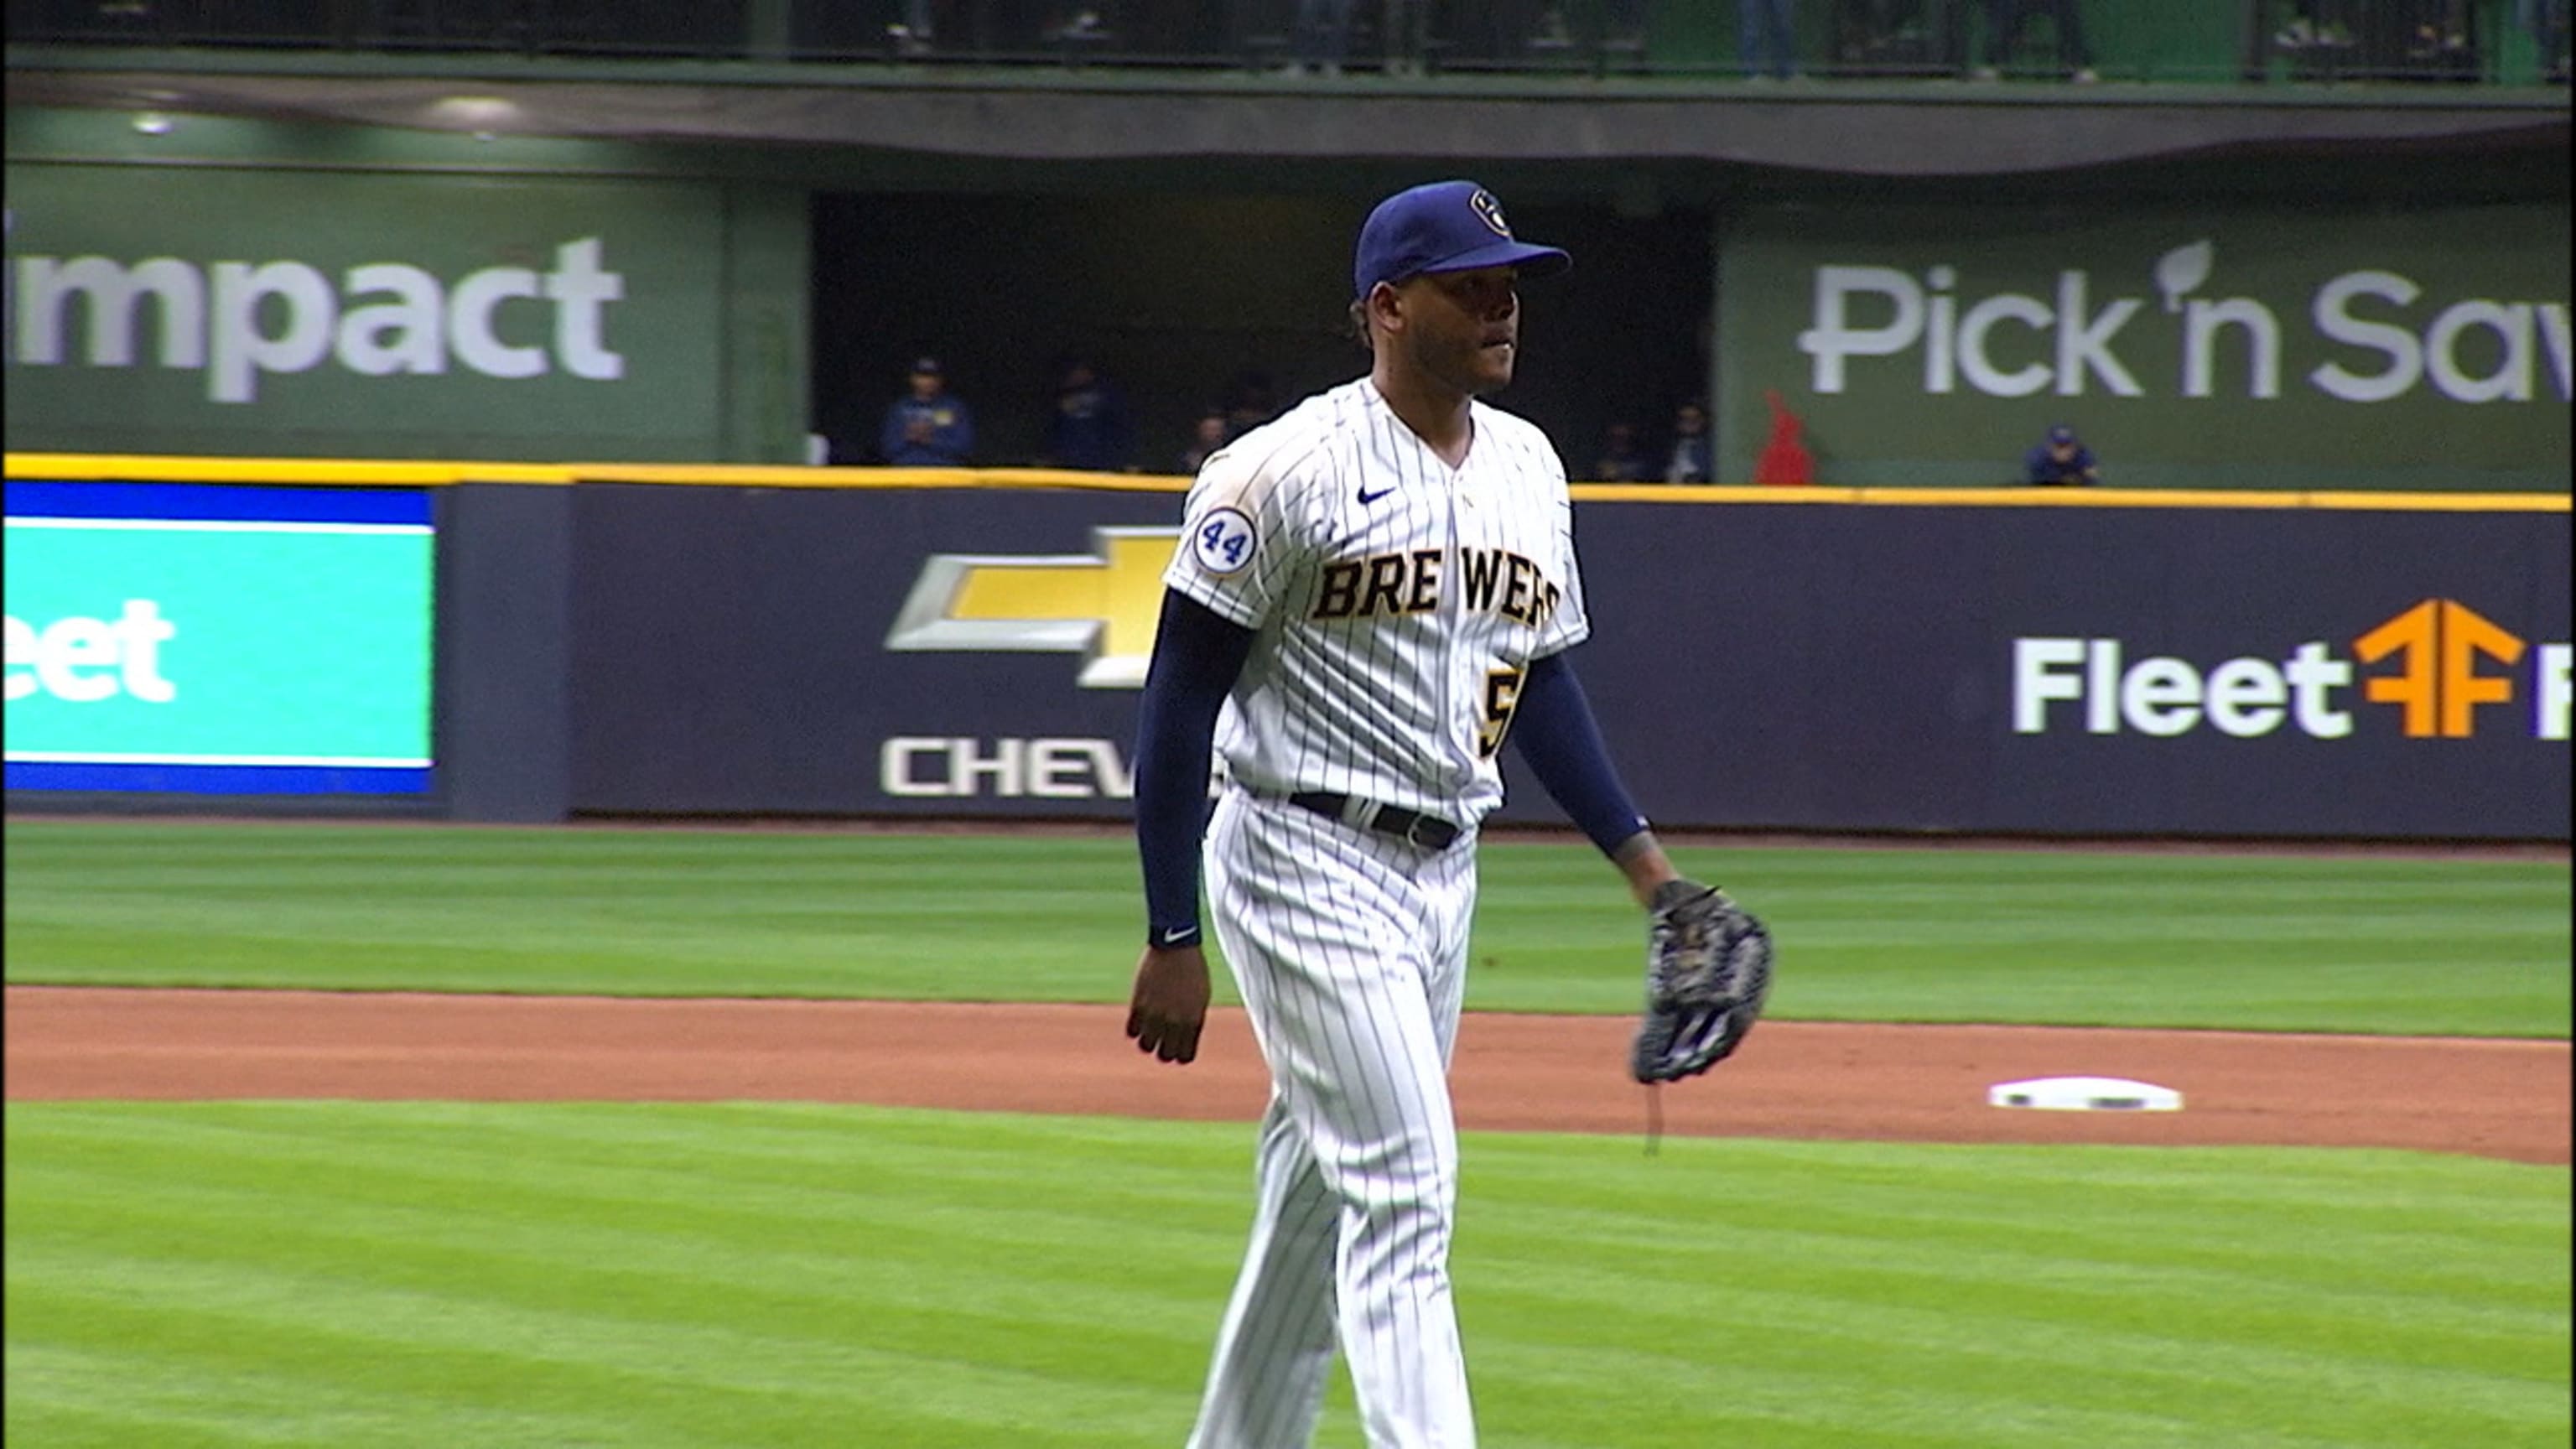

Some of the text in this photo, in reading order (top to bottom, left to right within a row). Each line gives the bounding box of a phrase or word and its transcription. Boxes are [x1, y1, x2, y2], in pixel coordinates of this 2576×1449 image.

[5, 211, 625, 402] mpact
[1202, 520, 1247, 565] 44
[2013, 637, 2354, 739] Fleet
